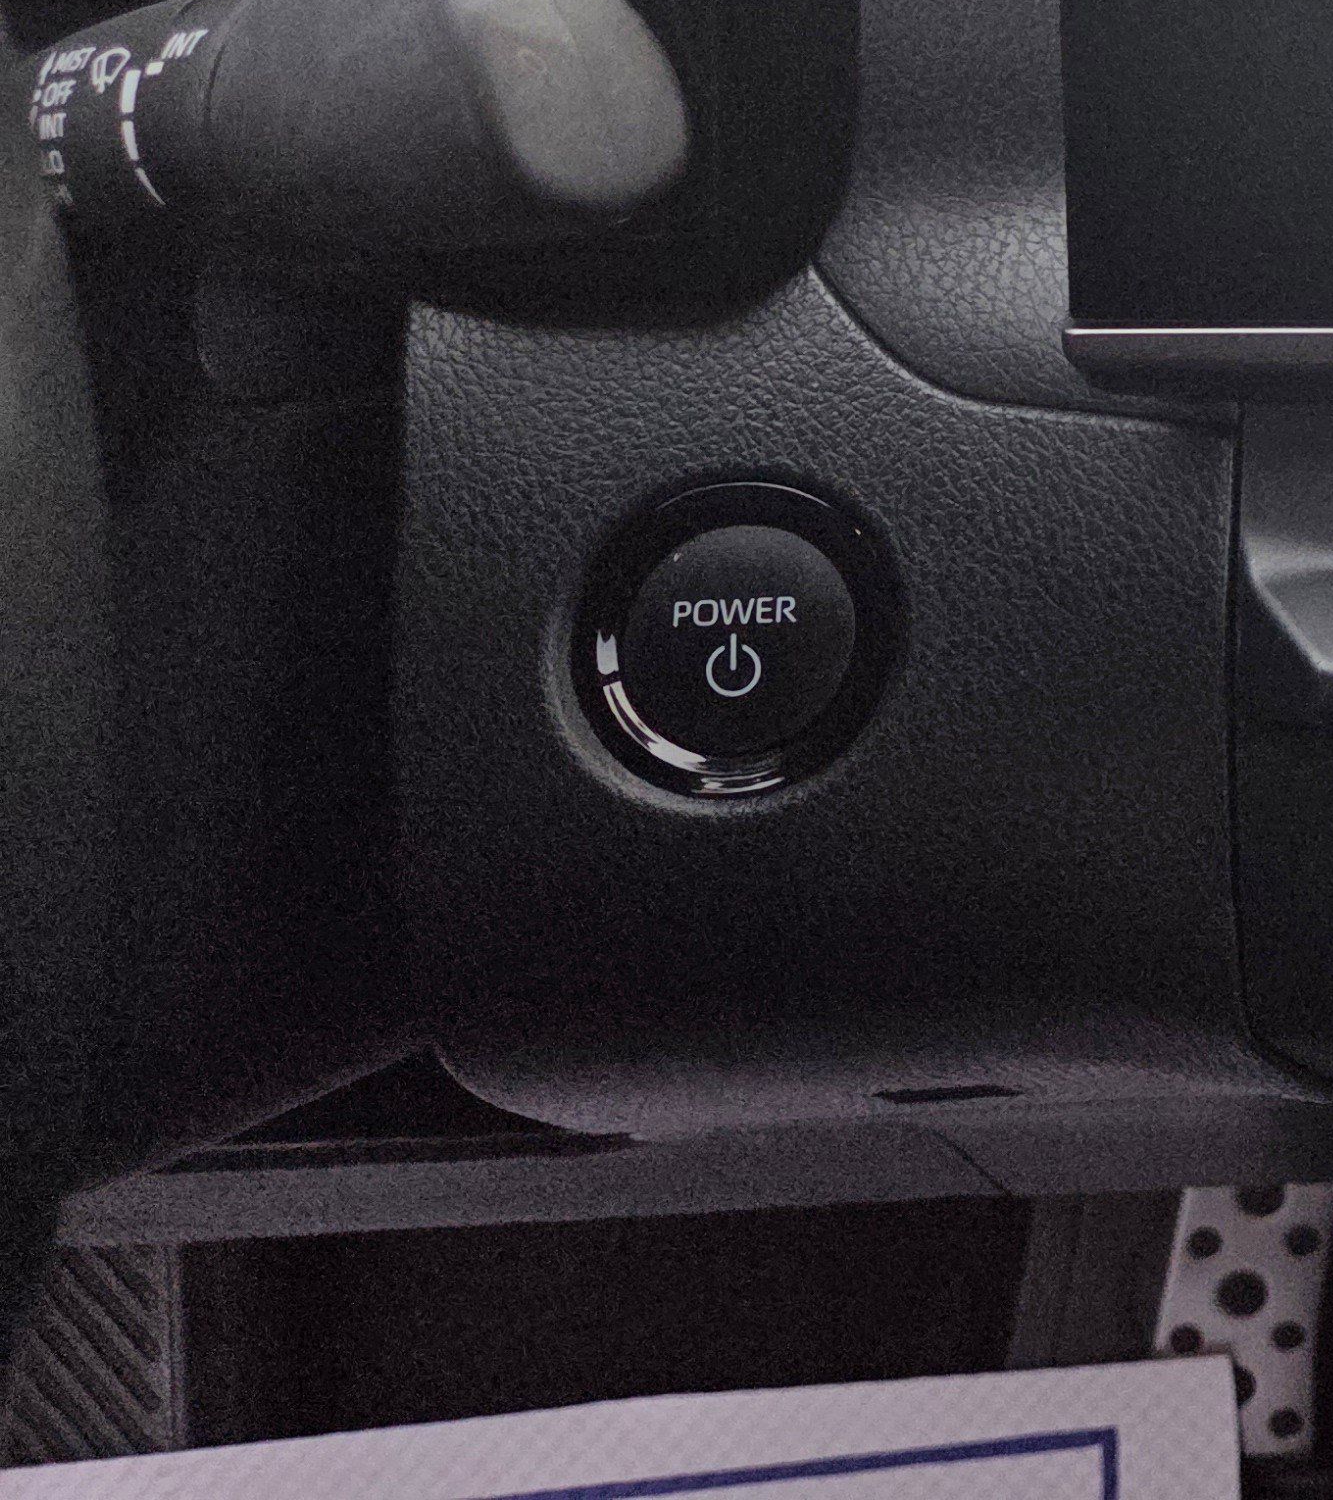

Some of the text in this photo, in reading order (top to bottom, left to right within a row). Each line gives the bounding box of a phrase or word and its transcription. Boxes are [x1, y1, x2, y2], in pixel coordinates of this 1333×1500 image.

[161, 30, 208, 59] INT
[42, 79, 77, 107] OFF
[672, 596, 797, 628] POWER
